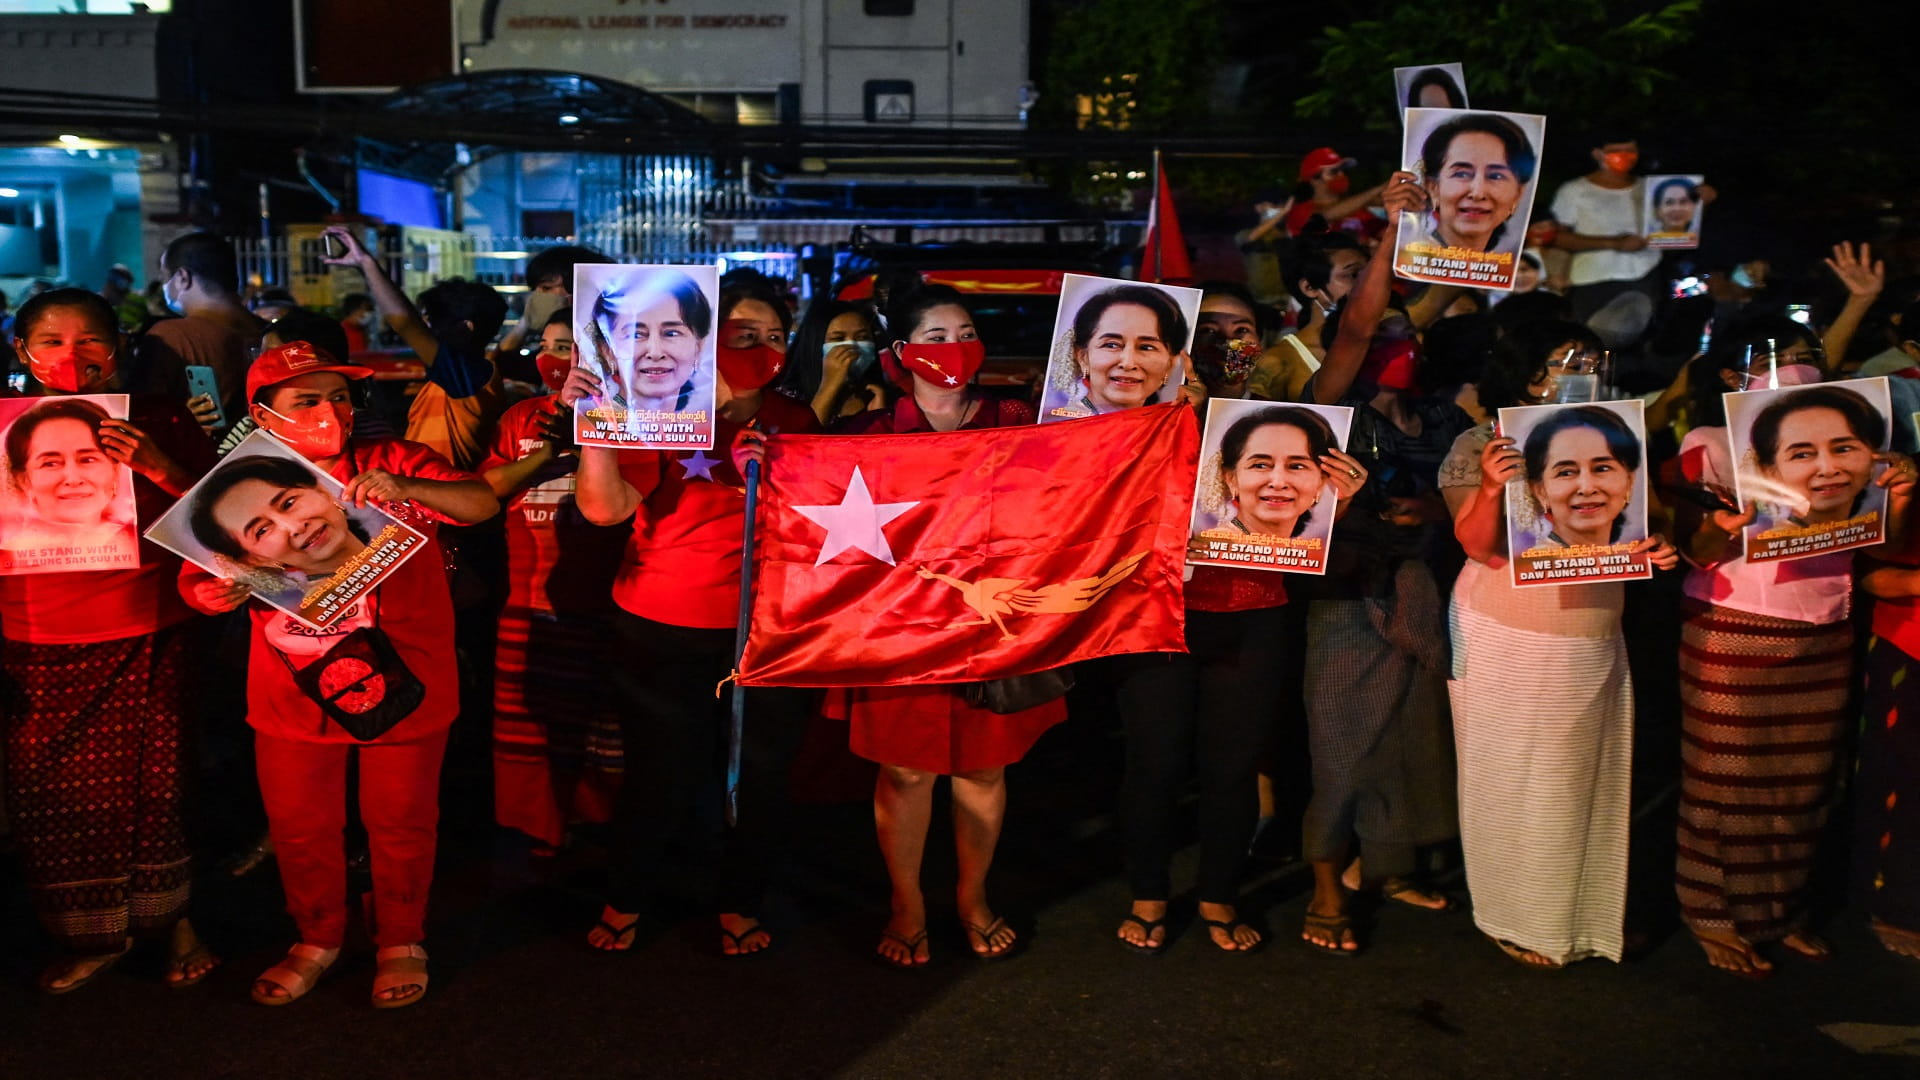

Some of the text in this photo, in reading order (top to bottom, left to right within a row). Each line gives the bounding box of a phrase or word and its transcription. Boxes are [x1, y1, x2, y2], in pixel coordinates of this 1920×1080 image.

[588, 16, 648, 29] LEAGUE
[655, 15, 685, 29] FOR
[691, 15, 787, 28] DEMOCRACY
[1413, 255, 1498, 273] WE STAND WITH
[1400, 264, 1509, 283] DAW AUNG SAN SUU KYI
[596, 421, 615, 431] WE
[663, 423, 694, 433] WITH
[582, 430, 707, 443] DAW AUNG SAN SUU KYI
[1753, 531, 1877, 559] DAW AUNG SAN SUU KYI
[1768, 541, 1788, 550] WE
[1791, 533, 1832, 546] STAND
[1835, 525, 1865, 537] WITH
[17, 544, 118, 558] WE STAND WITH
[1210, 541, 1228, 551] WE
[1231, 543, 1273, 555] STAND
[1276, 547, 1308, 558] WITH
[65, 556, 87, 565] SAN
[90, 554, 111, 563] SUU
[113, 553, 133, 562] KYI
[1221, 551, 1250, 562] AUNG
[1252, 554, 1275, 564] SAN
[1277, 557, 1298, 566] SUU
[1533, 555, 1630, 570] WE STAND WITH
[316, 603, 340, 622] DAW
[338, 583, 364, 605] AUNG
[361, 567, 383, 584] SAN
[381, 551, 400, 567] SUU
[397, 536, 416, 552] KYI
[317, 539, 399, 609] WE STAND WITH
[1520, 564, 1644, 580] DAW AUNG SAN SUU KYI
